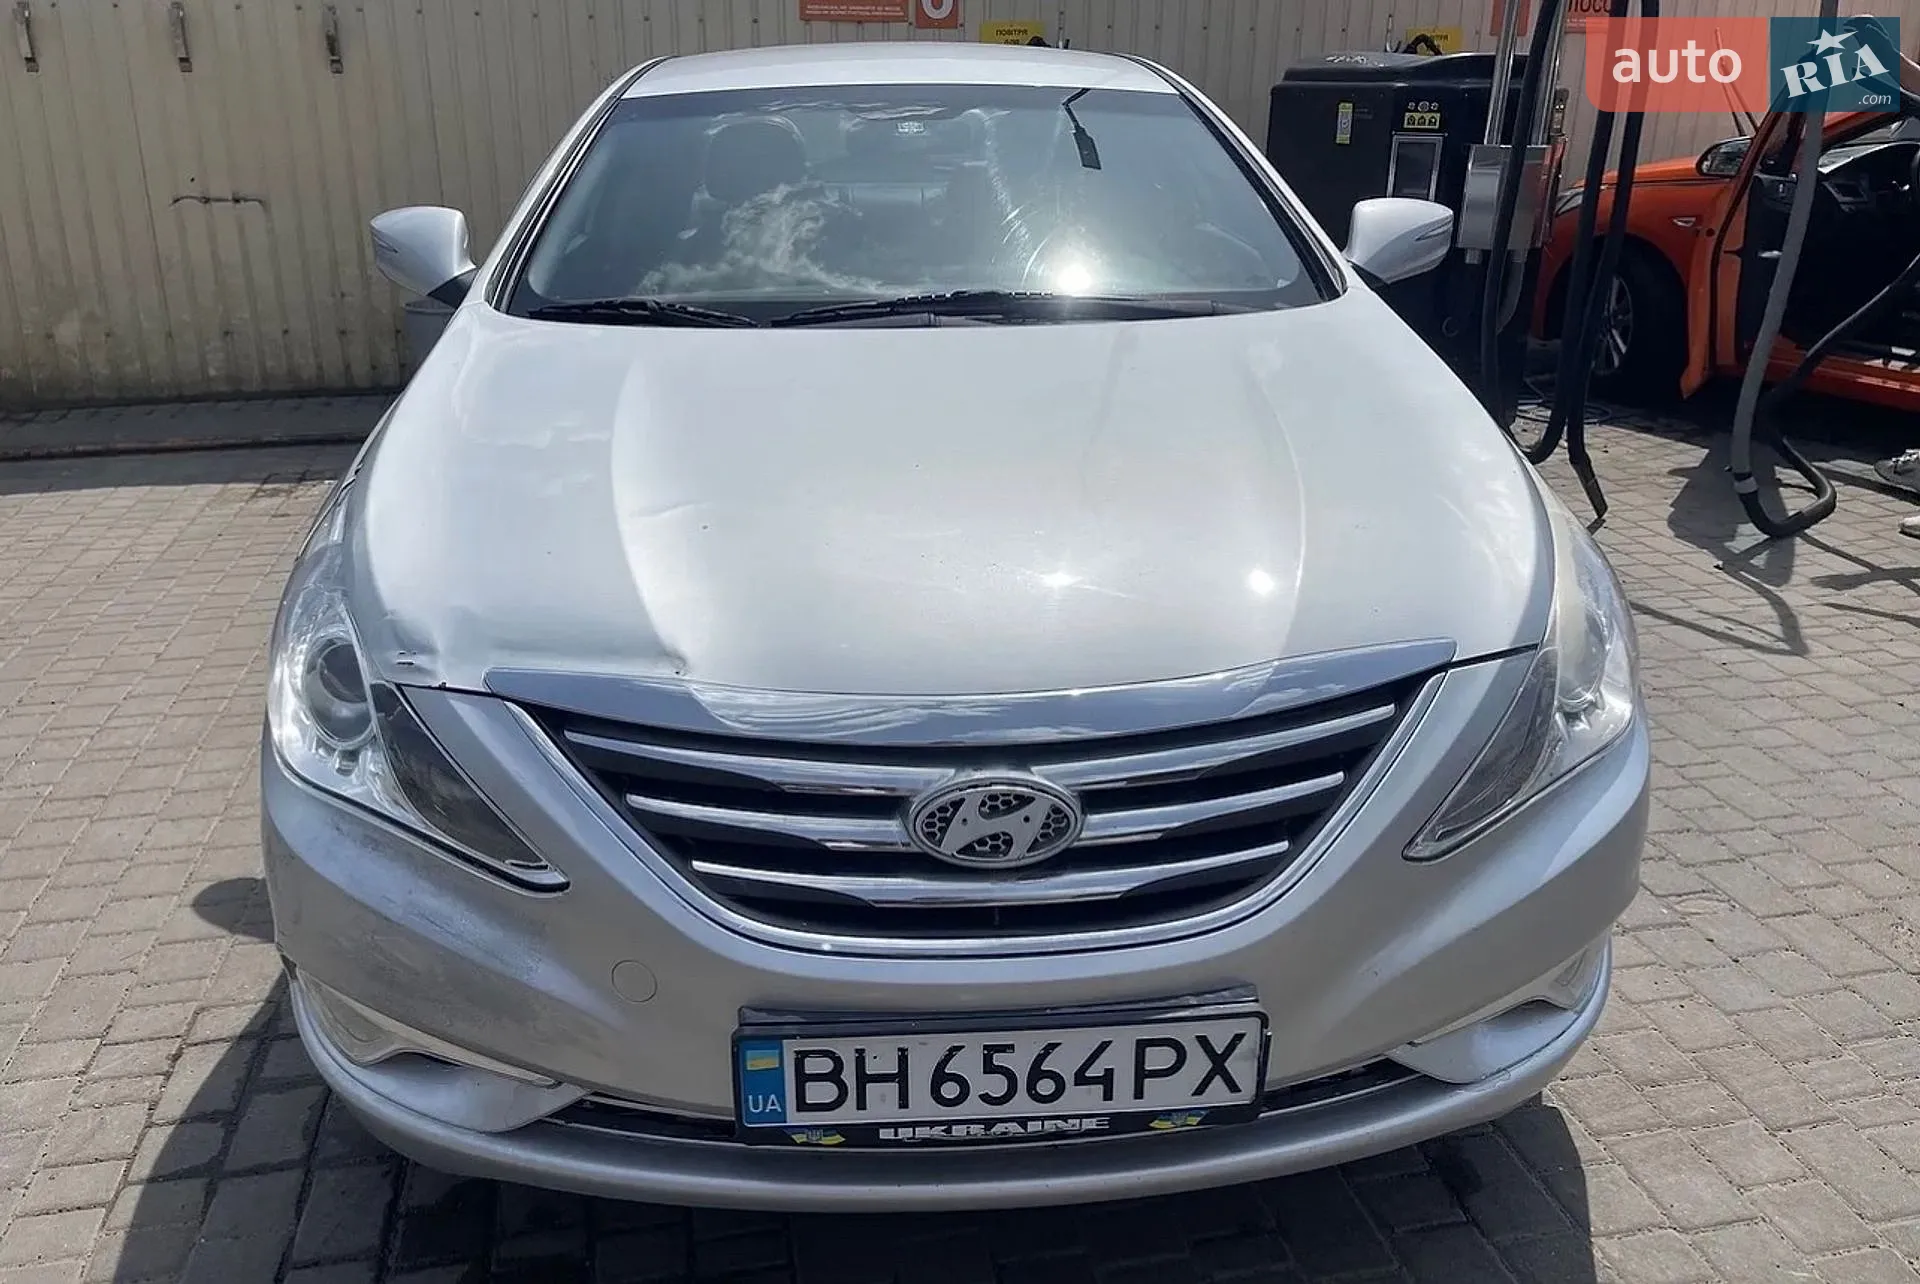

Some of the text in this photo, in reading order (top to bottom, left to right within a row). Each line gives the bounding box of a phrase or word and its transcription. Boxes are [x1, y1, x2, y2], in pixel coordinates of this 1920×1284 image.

[930, 1039, 1115, 1108] 6564
[749, 1094, 782, 1113] UA
[879, 1117, 1111, 1142] UKRAINE
